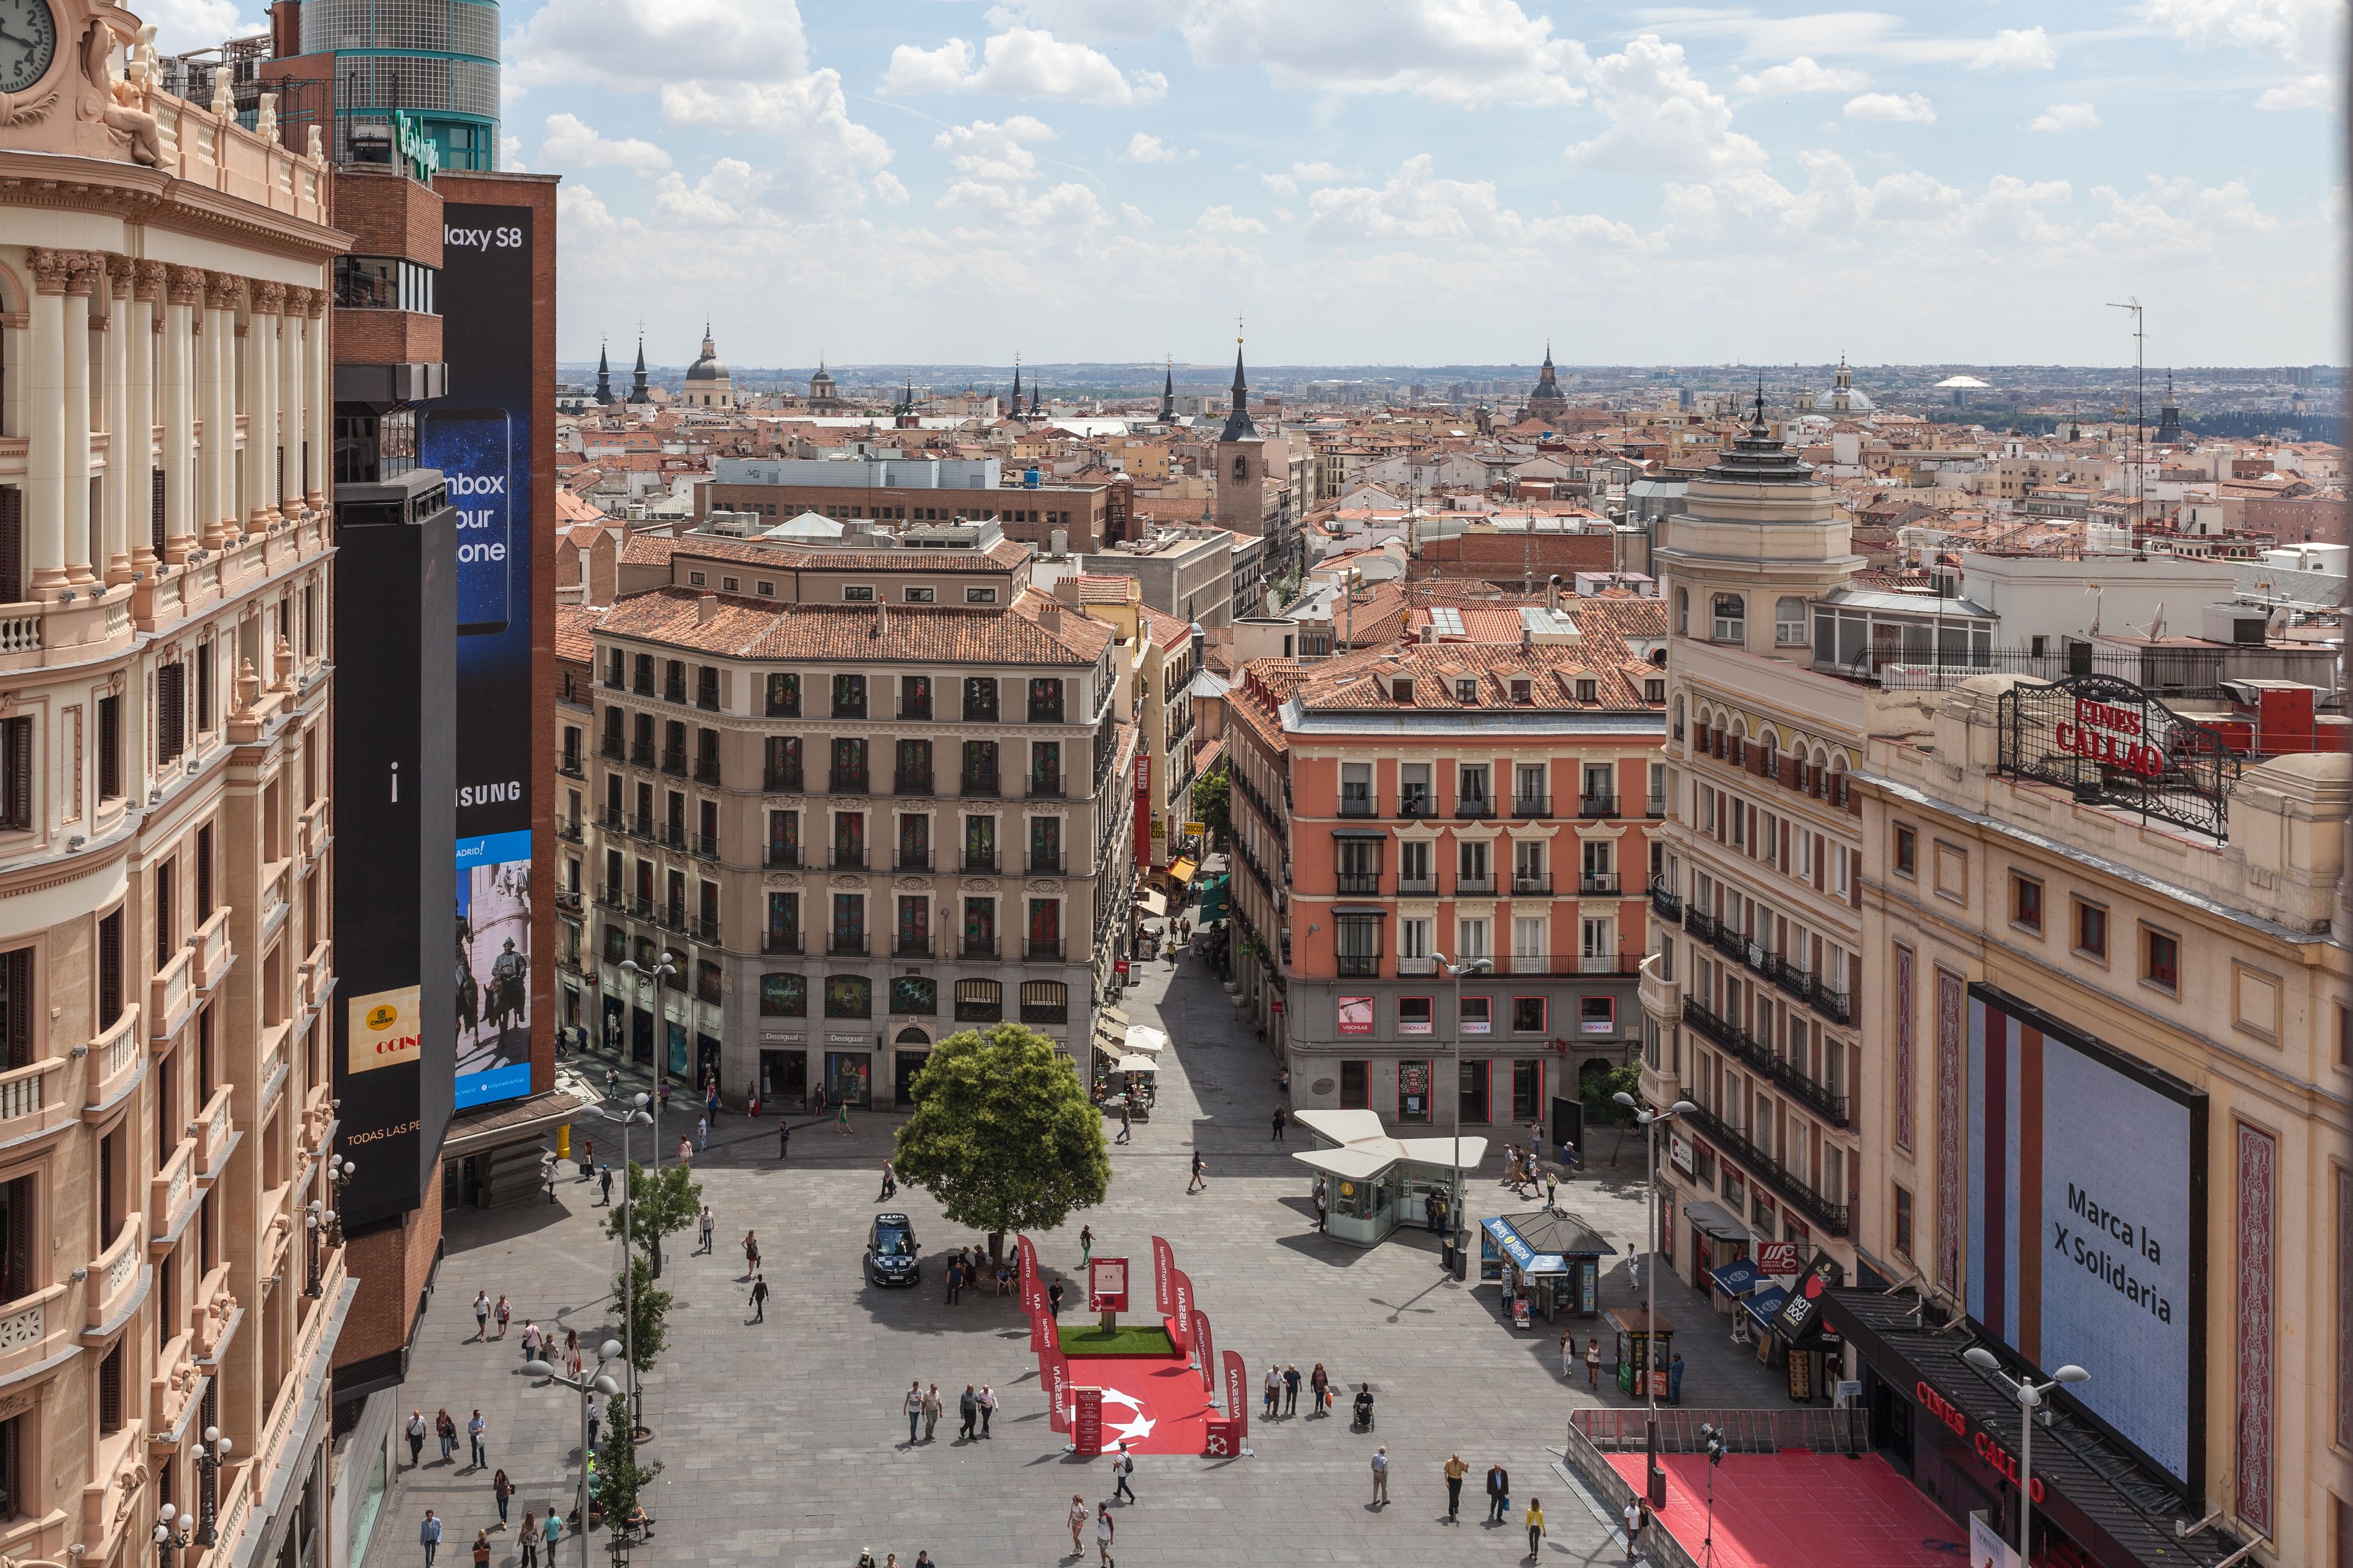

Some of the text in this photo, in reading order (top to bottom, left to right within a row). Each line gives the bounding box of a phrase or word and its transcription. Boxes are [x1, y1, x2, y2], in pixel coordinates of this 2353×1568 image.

[27, 10, 37, 27] 2
[34, 29, 43, 46] 3
[24, 49, 35, 66] 4
[13, 60, 23, 77] 5
[444, 224, 522, 252] laxy S8
[456, 543, 506, 563] one
[2076, 698, 2141, 736] CINES
[2056, 722, 2163, 776] CALLAO
[1137, 759, 1148, 798] CENTRAL LA
[456, 781, 520, 807] SUNG
[1151, 830, 1165, 839] COS
[370, 1017, 393, 1026] CINESA
[767, 1033, 798, 1042] Desigual
[831, 1034, 863, 1043] Desigual
[347, 1129, 384, 1146] TODAS
[387, 1123, 407, 1137] LAS
[2068, 1182, 2161, 1266] Marca la
[1490, 1220, 1529, 1260] TOURS TOLEDO
[2055, 1221, 2170, 1325] X Solidaria
[1786, 1303, 1804, 1321] DOG
[1792, 1294, 1812, 1313] HOT
[1783, 1312, 1799, 1327] GOURMET
[1917, 1381, 1967, 1437] CINES
[1975, 1431, 2045, 1503] CALLO
